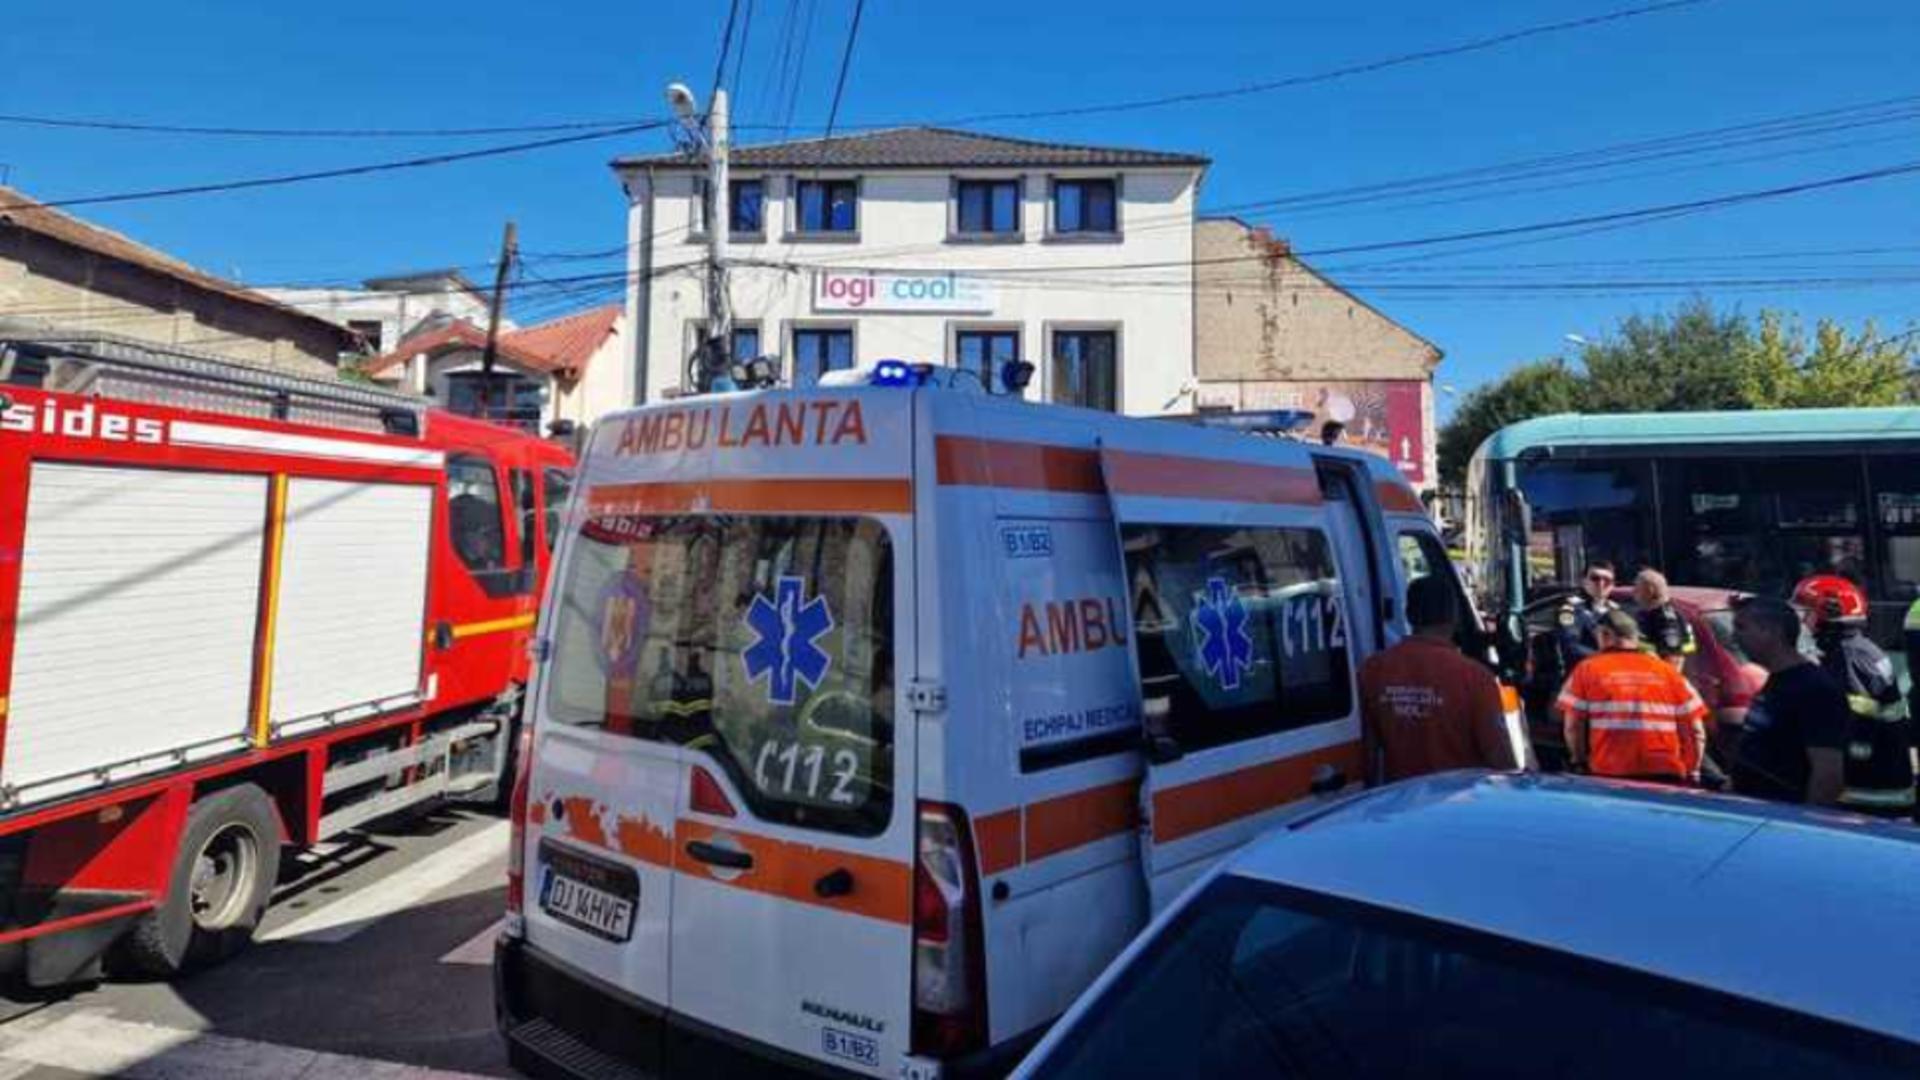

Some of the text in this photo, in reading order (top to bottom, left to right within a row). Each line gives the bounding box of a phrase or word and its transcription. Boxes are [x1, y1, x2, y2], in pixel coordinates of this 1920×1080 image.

[820, 271, 875, 306] logi
[892, 271, 956, 299] cool
[0, 397, 164, 444] sides
[779, 742, 858, 804] 112
[825, 1033, 875, 1062] B1/B2
